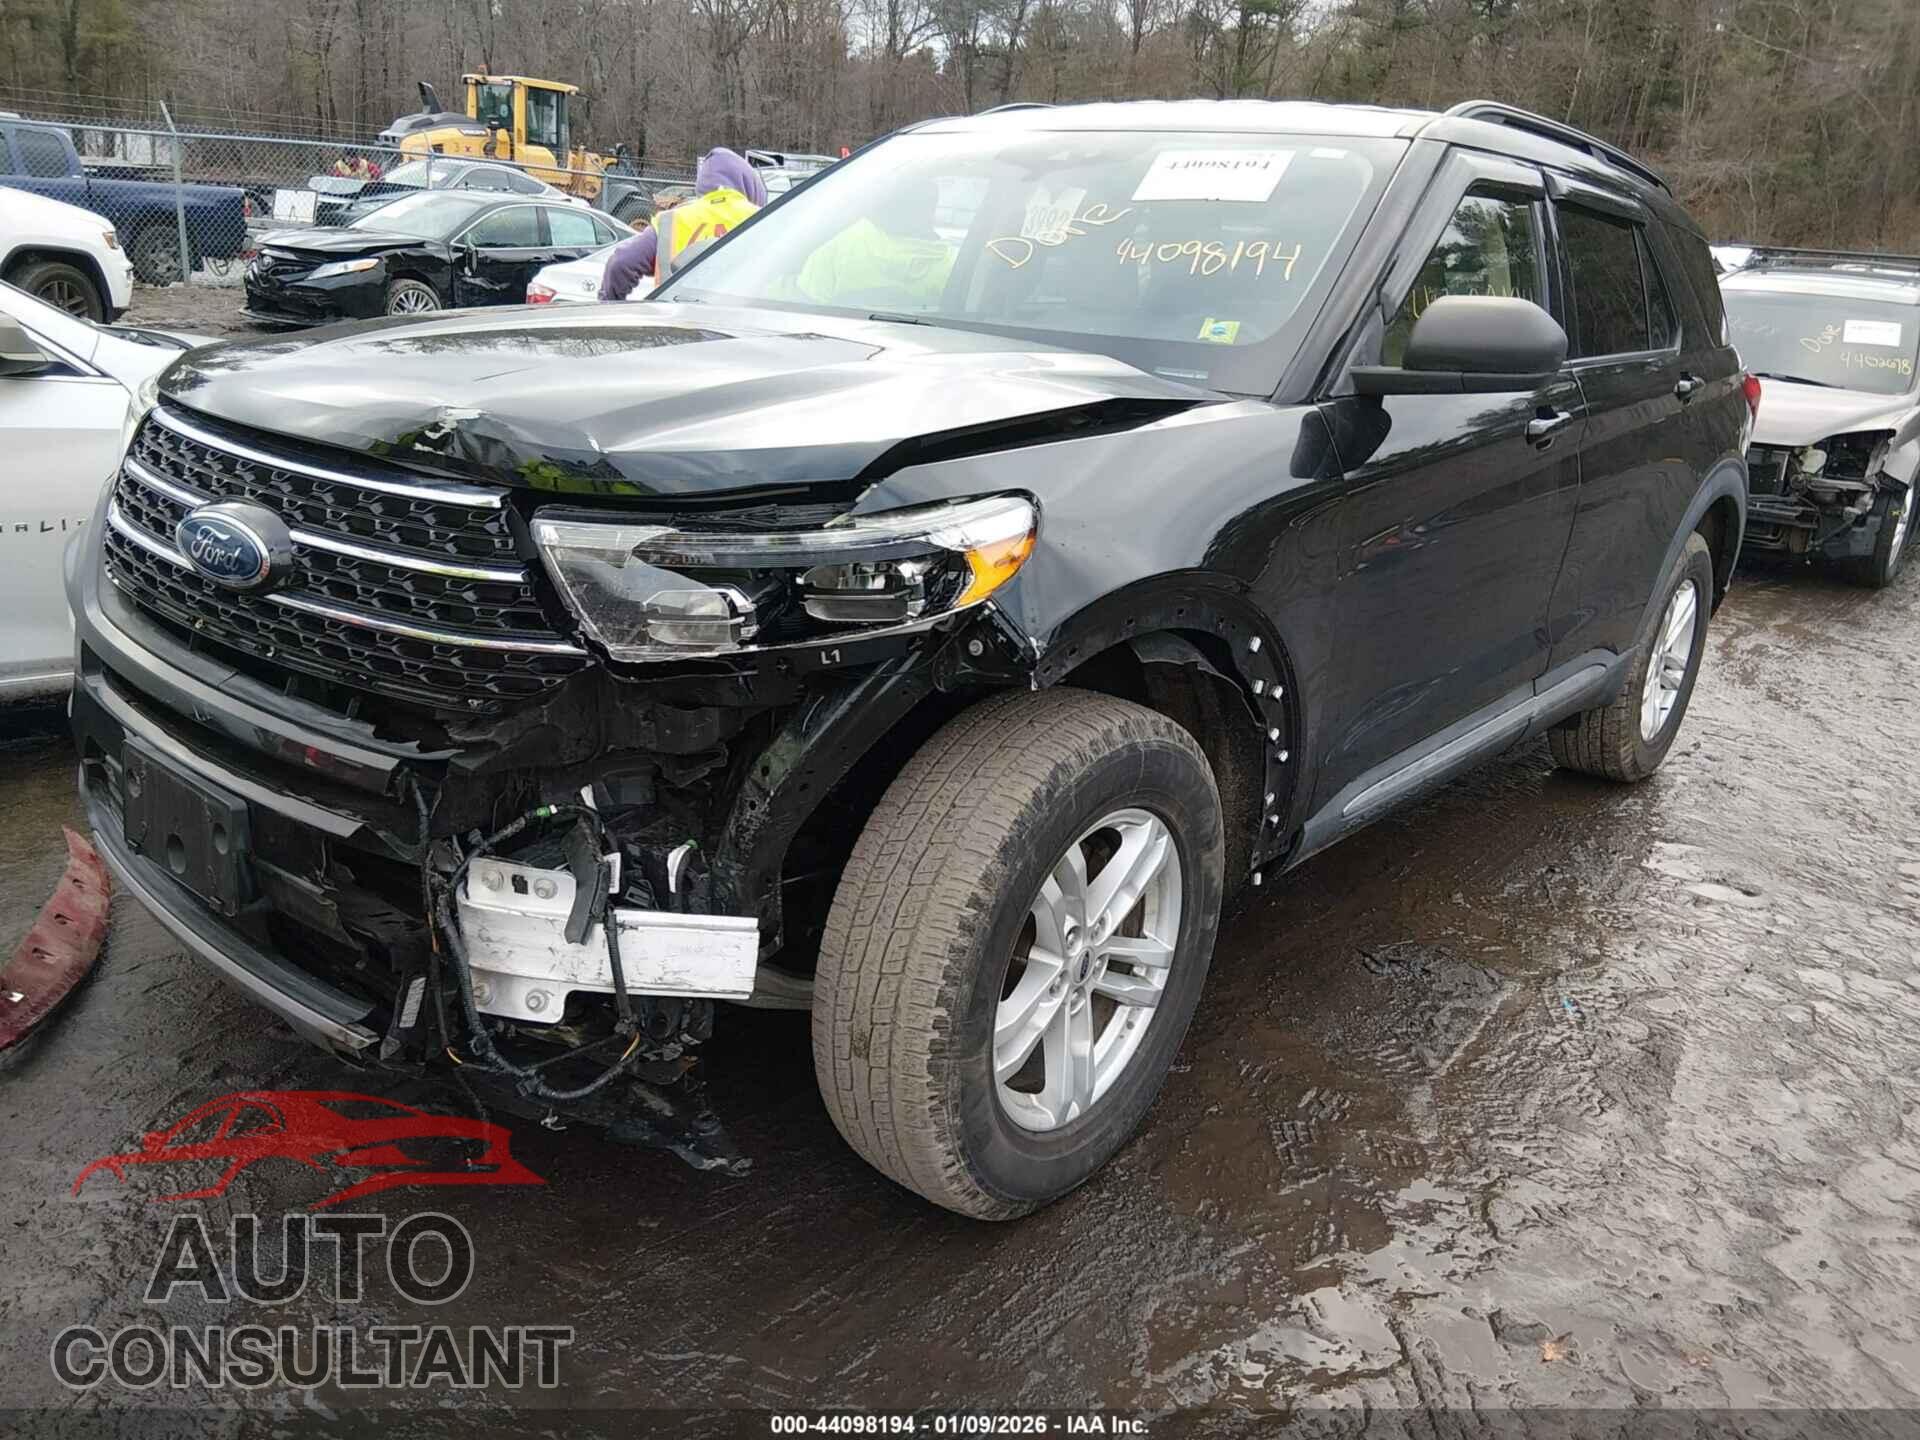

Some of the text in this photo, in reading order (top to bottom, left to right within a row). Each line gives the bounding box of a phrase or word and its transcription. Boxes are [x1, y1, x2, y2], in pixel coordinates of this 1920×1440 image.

[1116, 238, 1301, 281] 44098194
[190, 525, 243, 572] Ford
[820, 649, 841, 665] L1
